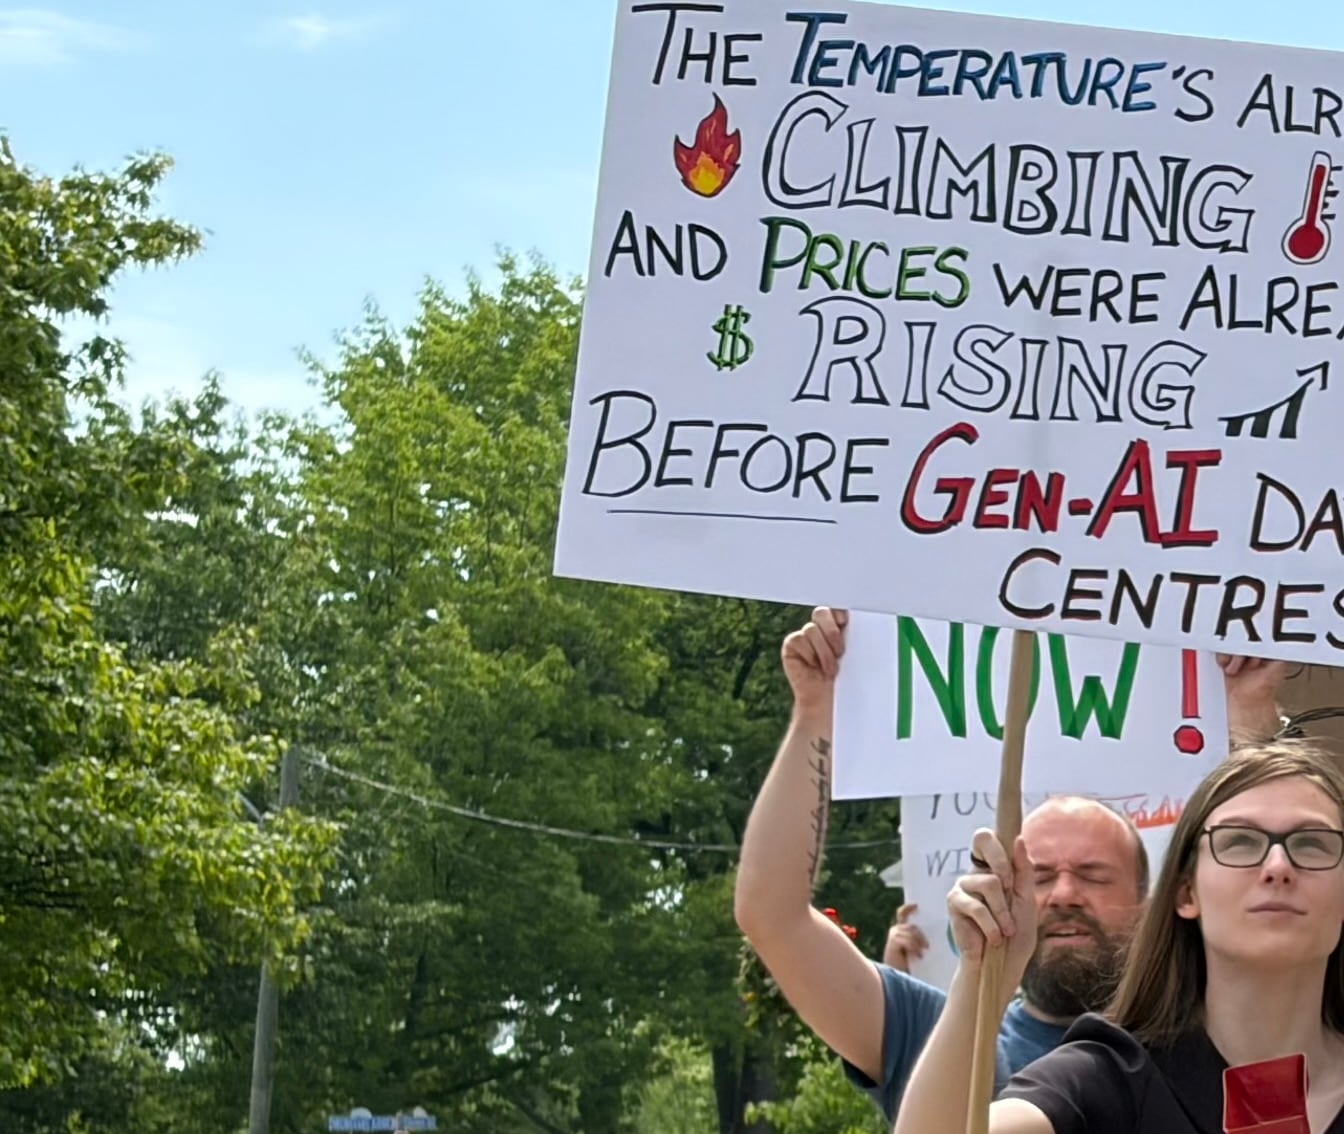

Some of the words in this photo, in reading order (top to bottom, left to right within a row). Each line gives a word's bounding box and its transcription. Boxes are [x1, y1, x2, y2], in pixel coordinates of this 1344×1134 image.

[632, 3, 763, 86] THE
[785, 10, 1216, 121] TEMPERATURE'S
[761, 92, 1254, 253] CLIMBING
[605, 210, 728, 284] AND
[759, 216, 971, 309] PRICES
[992, 262, 1167, 324] WERE
[792, 297, 1208, 432] RISING
[585, 390, 891, 504] BEFORE
[900, 421, 1224, 549] GEN-AI
